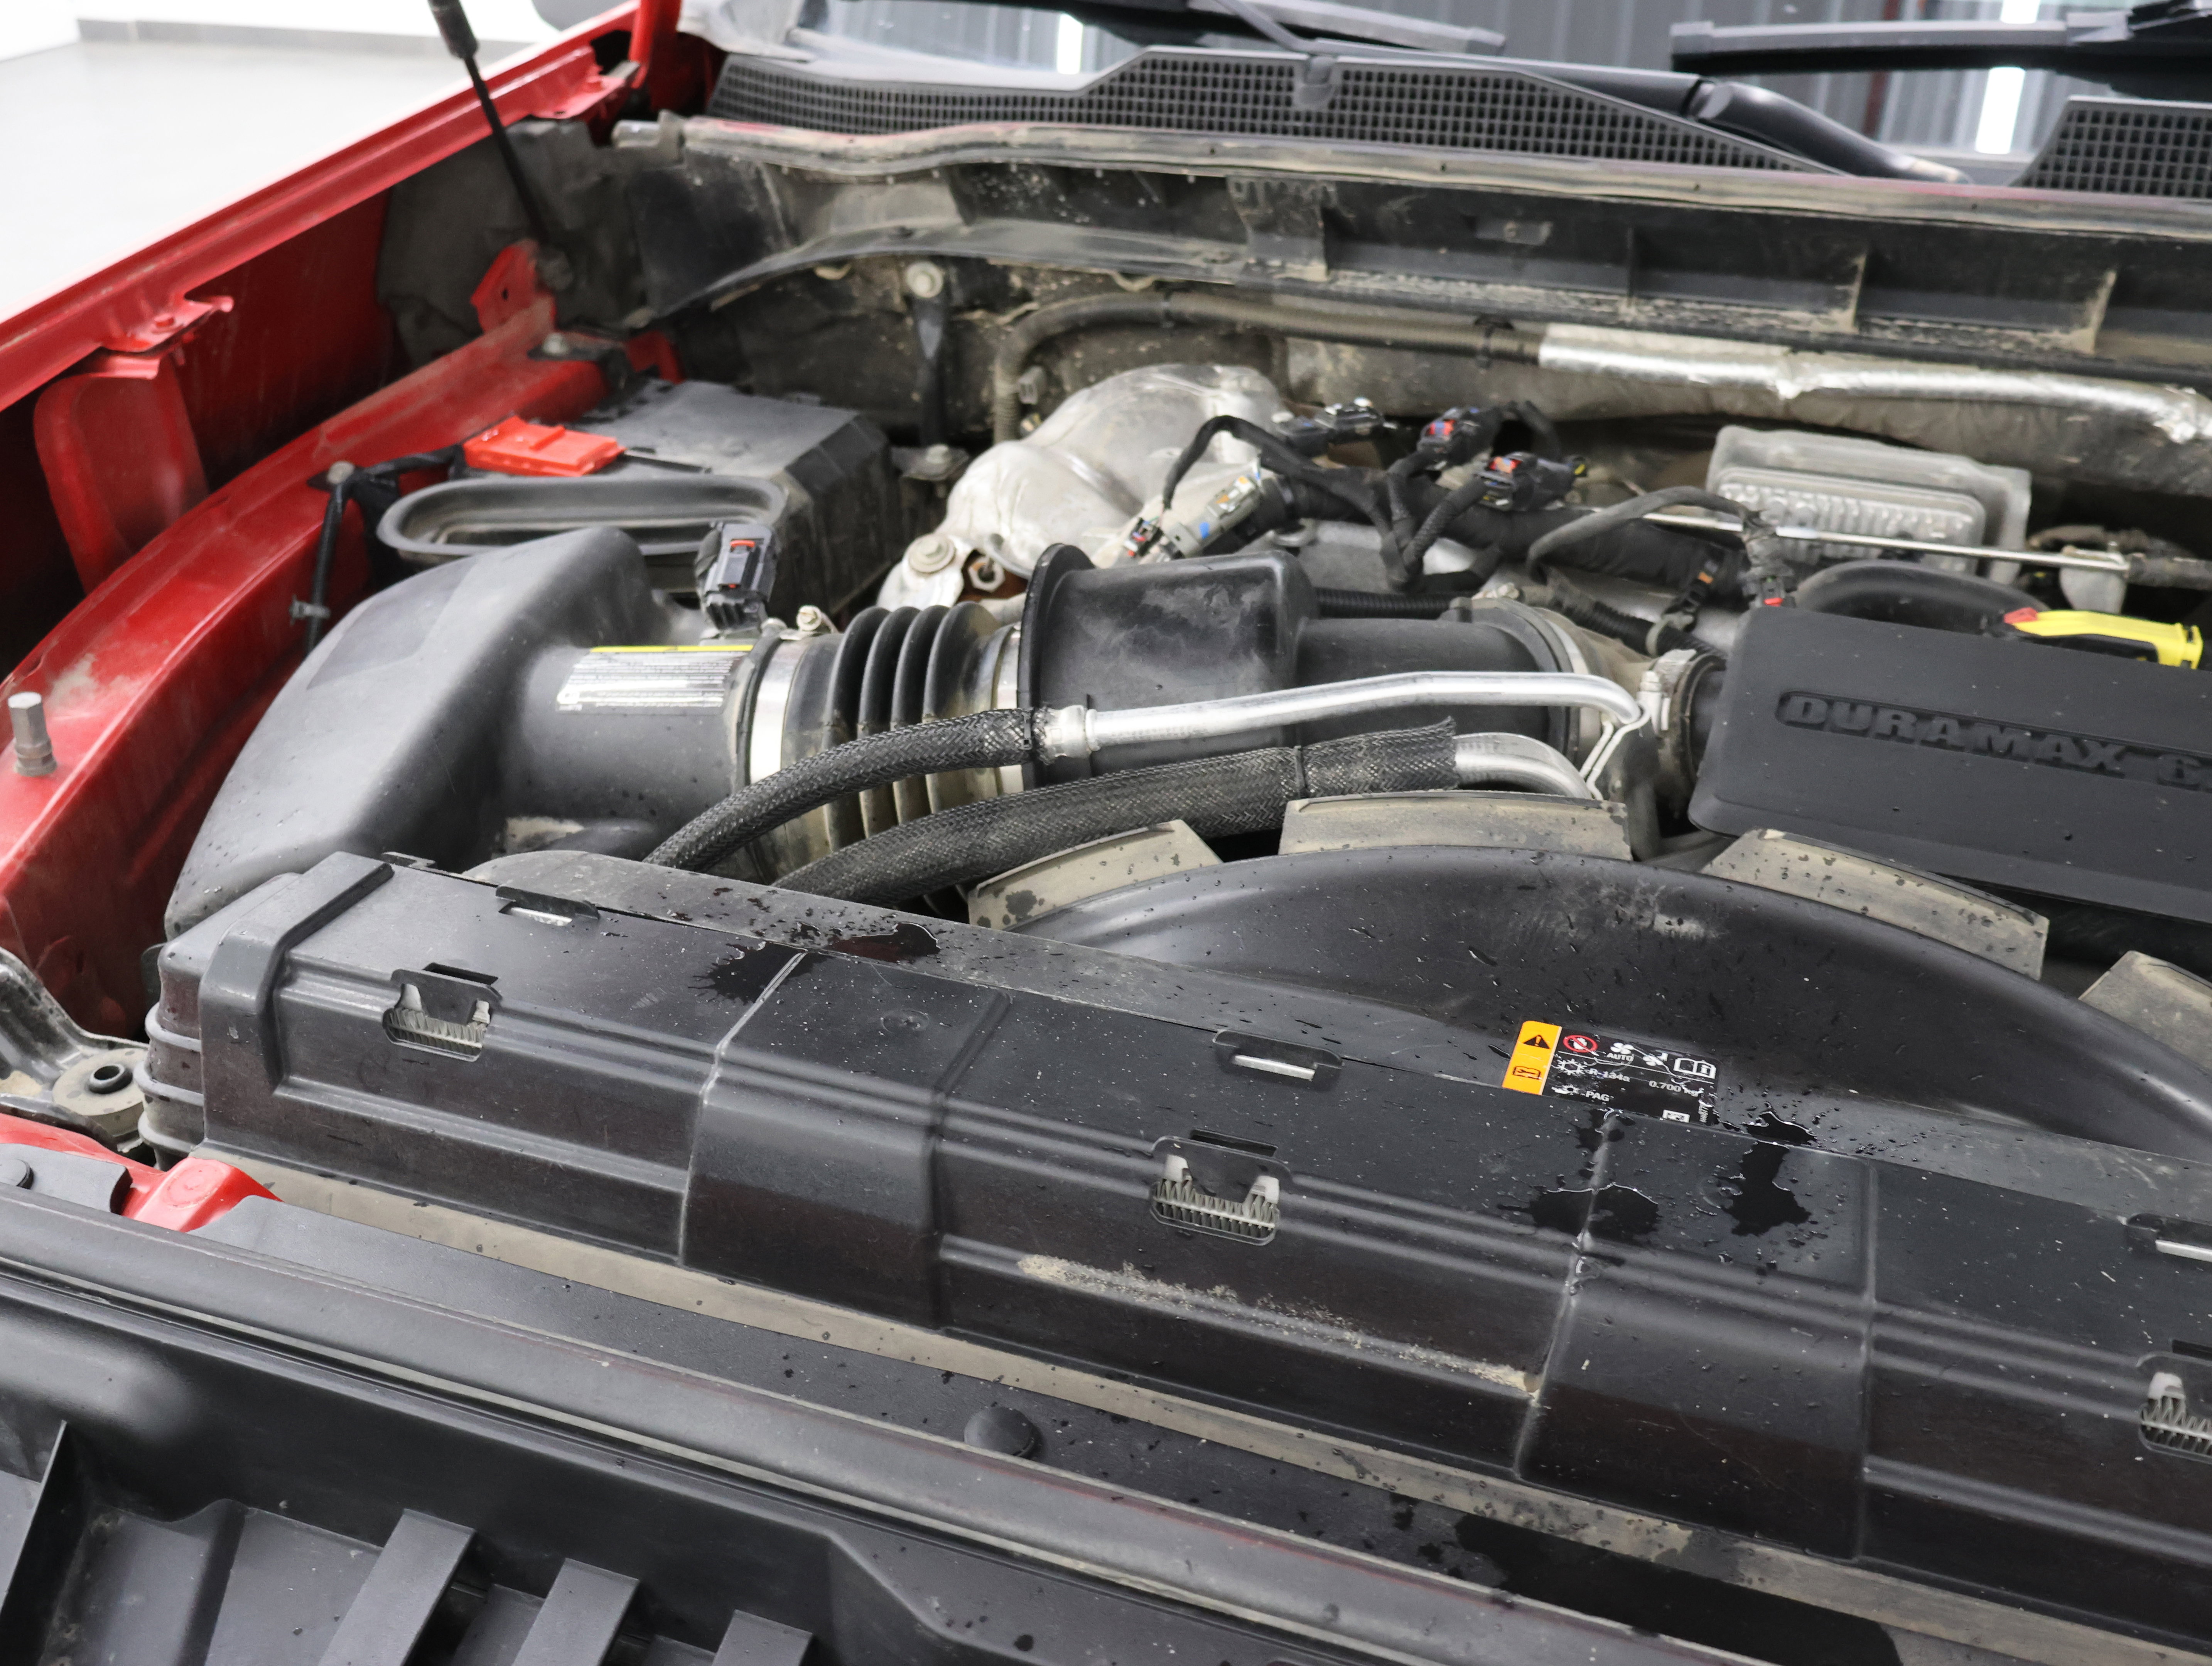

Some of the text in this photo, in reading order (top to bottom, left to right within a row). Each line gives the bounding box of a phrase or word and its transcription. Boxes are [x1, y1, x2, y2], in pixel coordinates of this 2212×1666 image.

[1783, 695, 2126, 777] DURAMAX
[1606, 1053, 1634, 1062] AUTO
[1589, 1068, 1630, 1083] R-134a
[1648, 1080, 1682, 1093] 0.700
[1585, 1091, 1610, 1102] PAG
